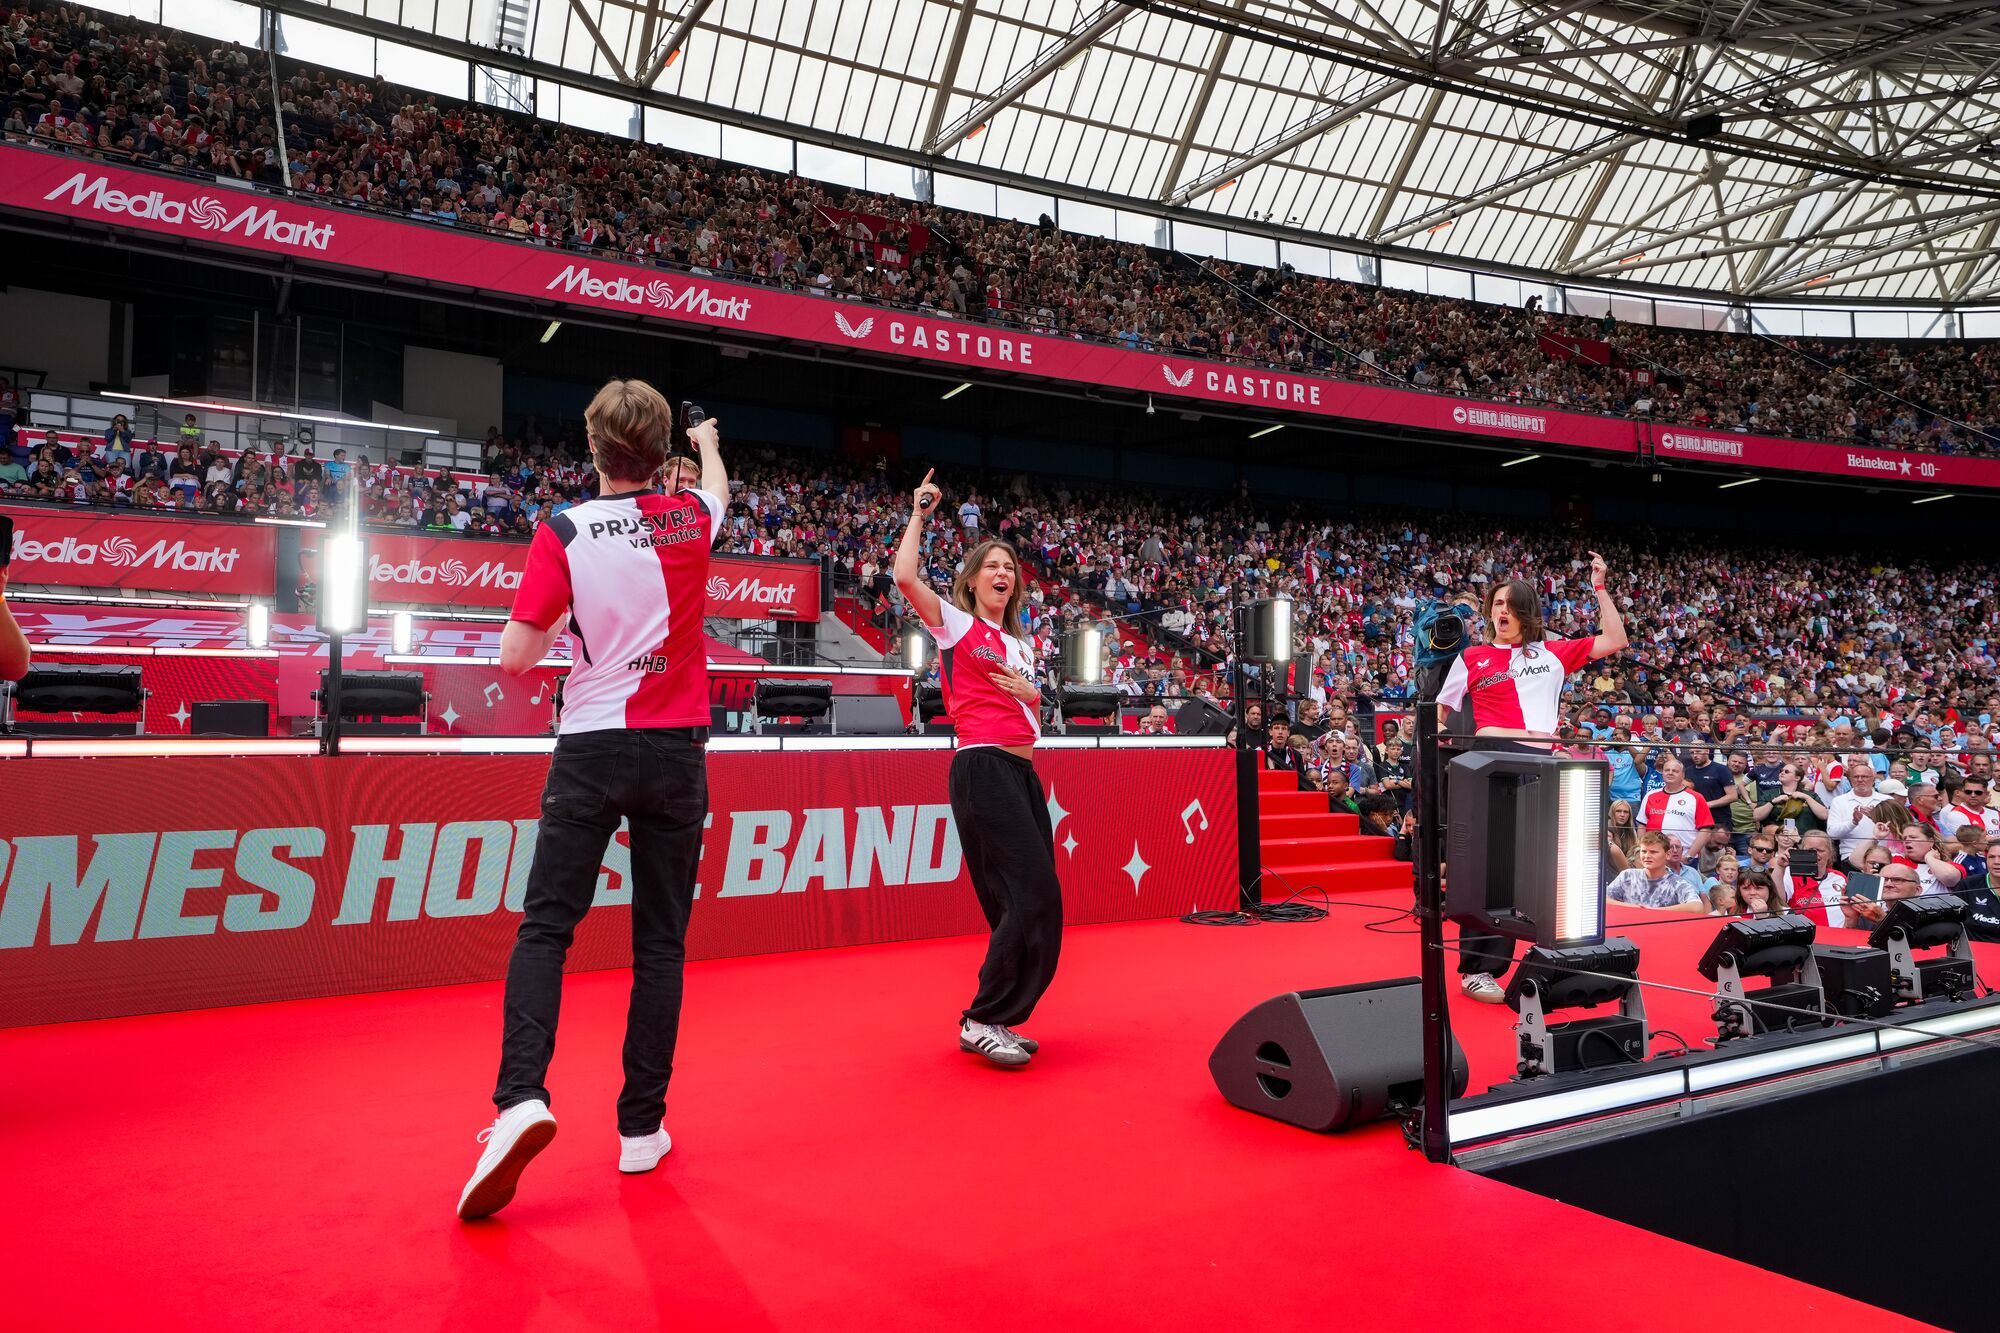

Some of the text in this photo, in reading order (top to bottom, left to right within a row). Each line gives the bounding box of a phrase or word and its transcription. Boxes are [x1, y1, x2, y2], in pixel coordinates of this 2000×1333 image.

[43, 172, 336, 251] Media Markt
[546, 264, 752, 321] Media Markt
[889, 321, 1033, 365] CASTORE
[1206, 371, 1321, 406] CASTORE
[1468, 409, 1545, 433] EUROJACKPOT
[1674, 435, 1744, 457] EUROJACKPOT
[1847, 453, 1897, 472] Heineken
[629, 526, 703, 549] vakanties
[132, 539, 241, 573] Markt
[726, 577, 797, 605] Markt
[1476, 664, 1551, 691] Media Markt
[0, 826, 327, 949] MES
[716, 803, 964, 899] BAND
